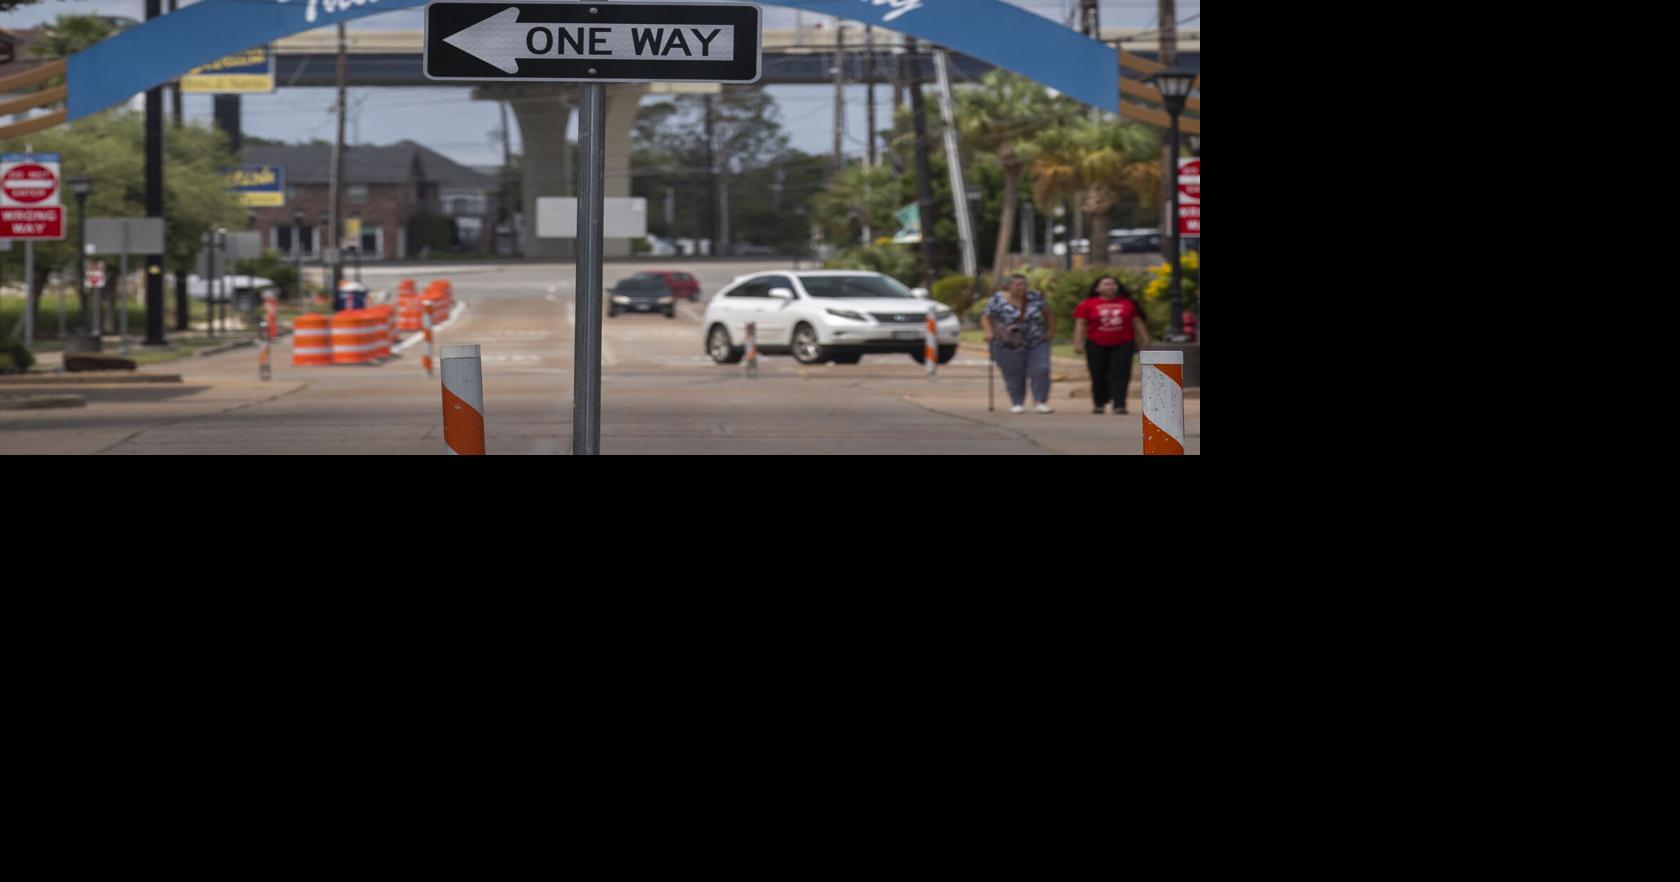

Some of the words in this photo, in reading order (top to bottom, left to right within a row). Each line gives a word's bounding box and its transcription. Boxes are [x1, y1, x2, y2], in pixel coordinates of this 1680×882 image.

[525, 26, 612, 56] ONE
[631, 27, 722, 57] WAY
[8, 170, 25, 179] DO
[27, 170, 50, 179] NOT
[1, 209, 57, 222] WRONG
[11, 223, 47, 234] WAY
